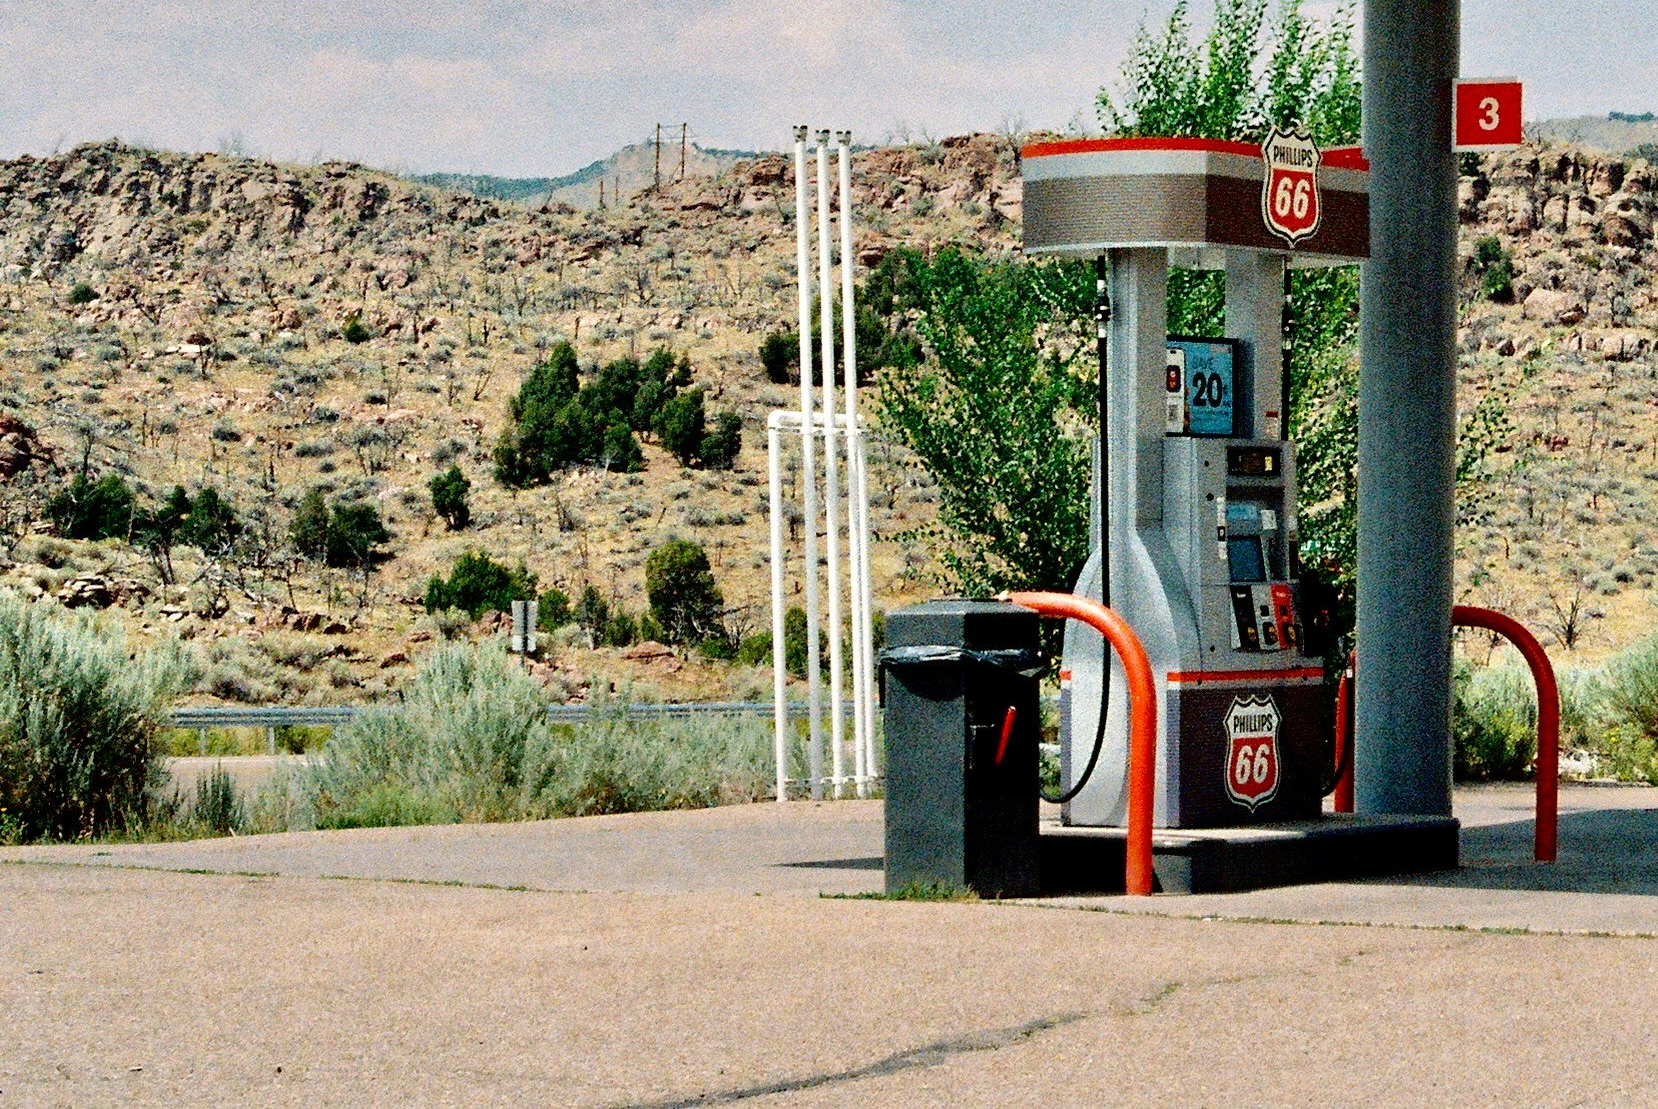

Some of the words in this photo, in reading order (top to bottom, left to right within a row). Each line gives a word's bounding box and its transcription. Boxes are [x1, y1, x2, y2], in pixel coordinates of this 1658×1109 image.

[1478, 96, 1500, 131] 3
[1273, 145, 1313, 167] PHILLIPS
[1275, 176, 1311, 219] 66
[1233, 714, 1273, 733] PHILLIPS
[1235, 743, 1270, 785] 66
